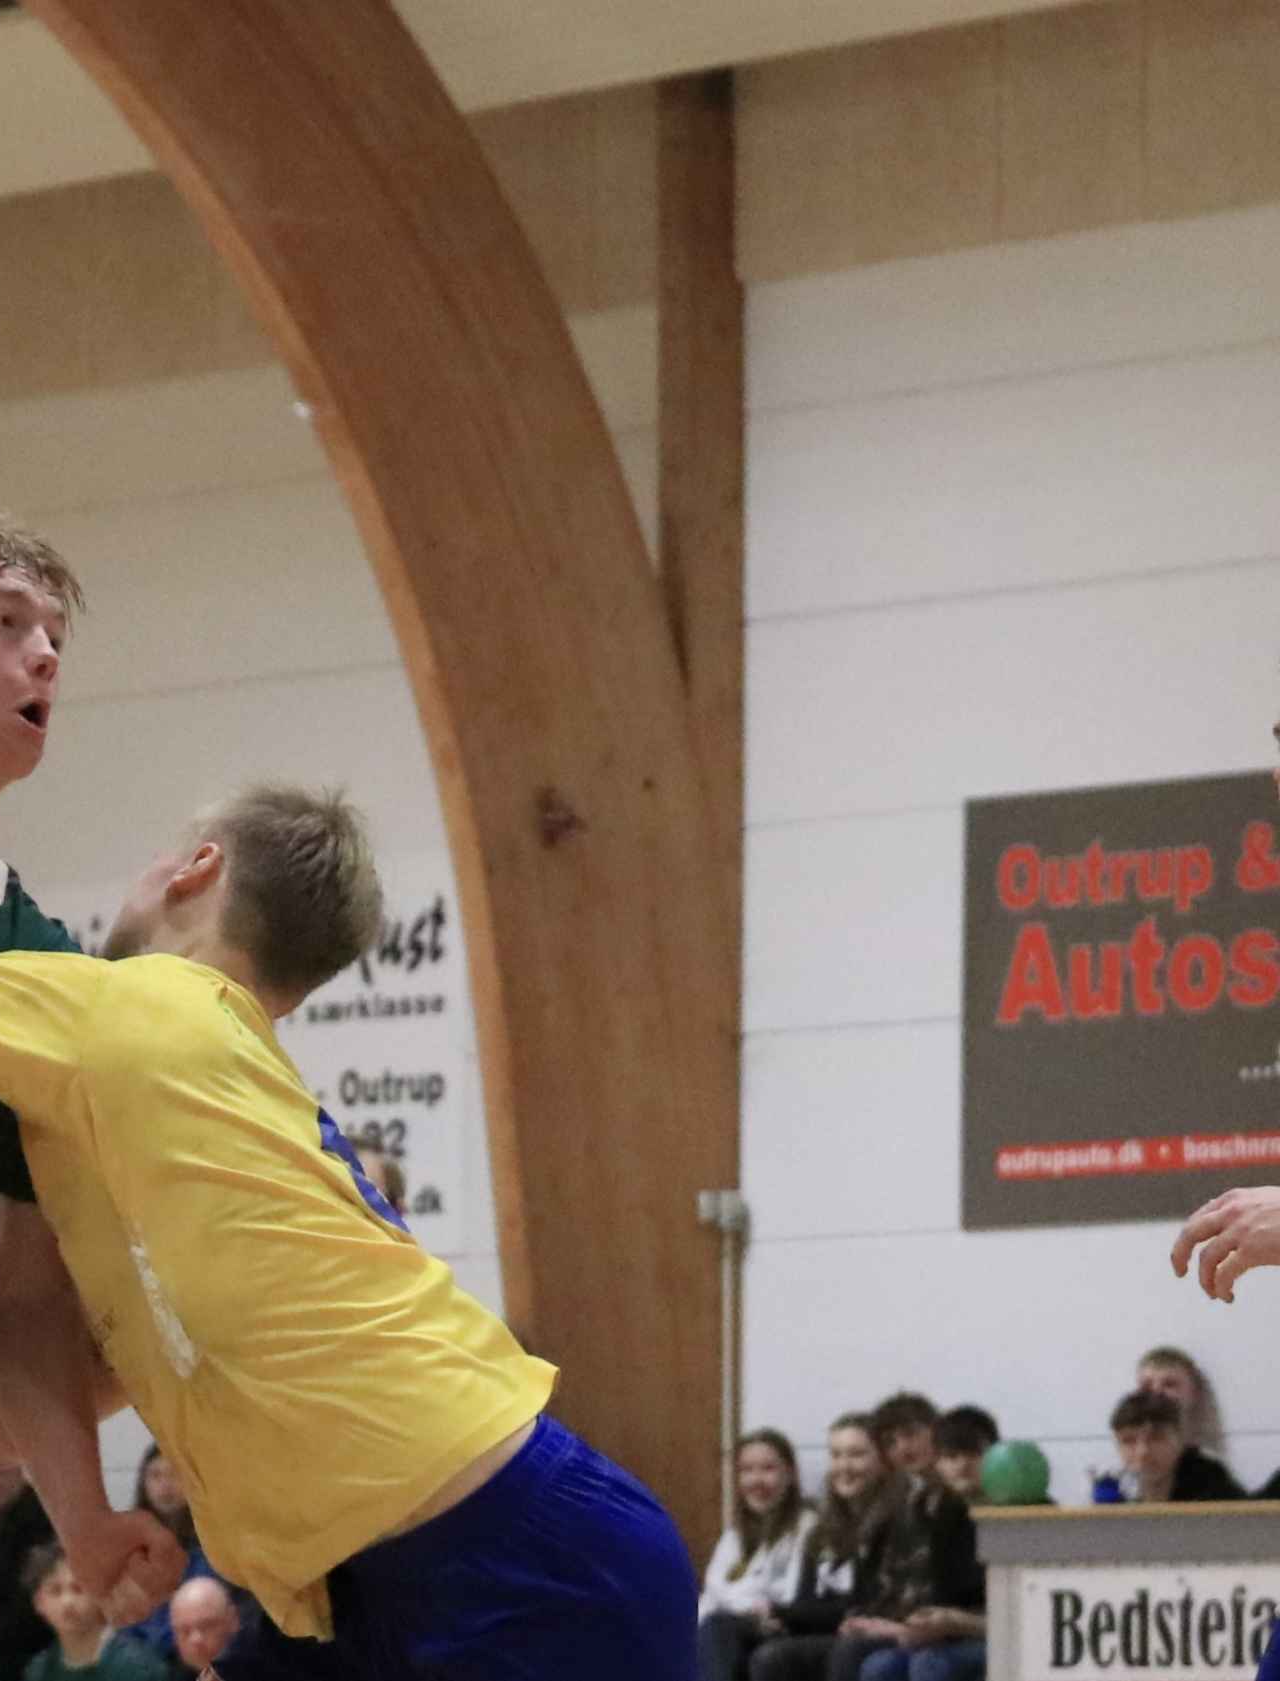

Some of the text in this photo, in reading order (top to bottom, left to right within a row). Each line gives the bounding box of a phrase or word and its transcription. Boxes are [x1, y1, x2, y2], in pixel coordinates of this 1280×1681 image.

[997, 820, 1280, 914] Outrup &
[996, 915, 1280, 1024] Autos
[339, 1069, 445, 1108] Outrup
